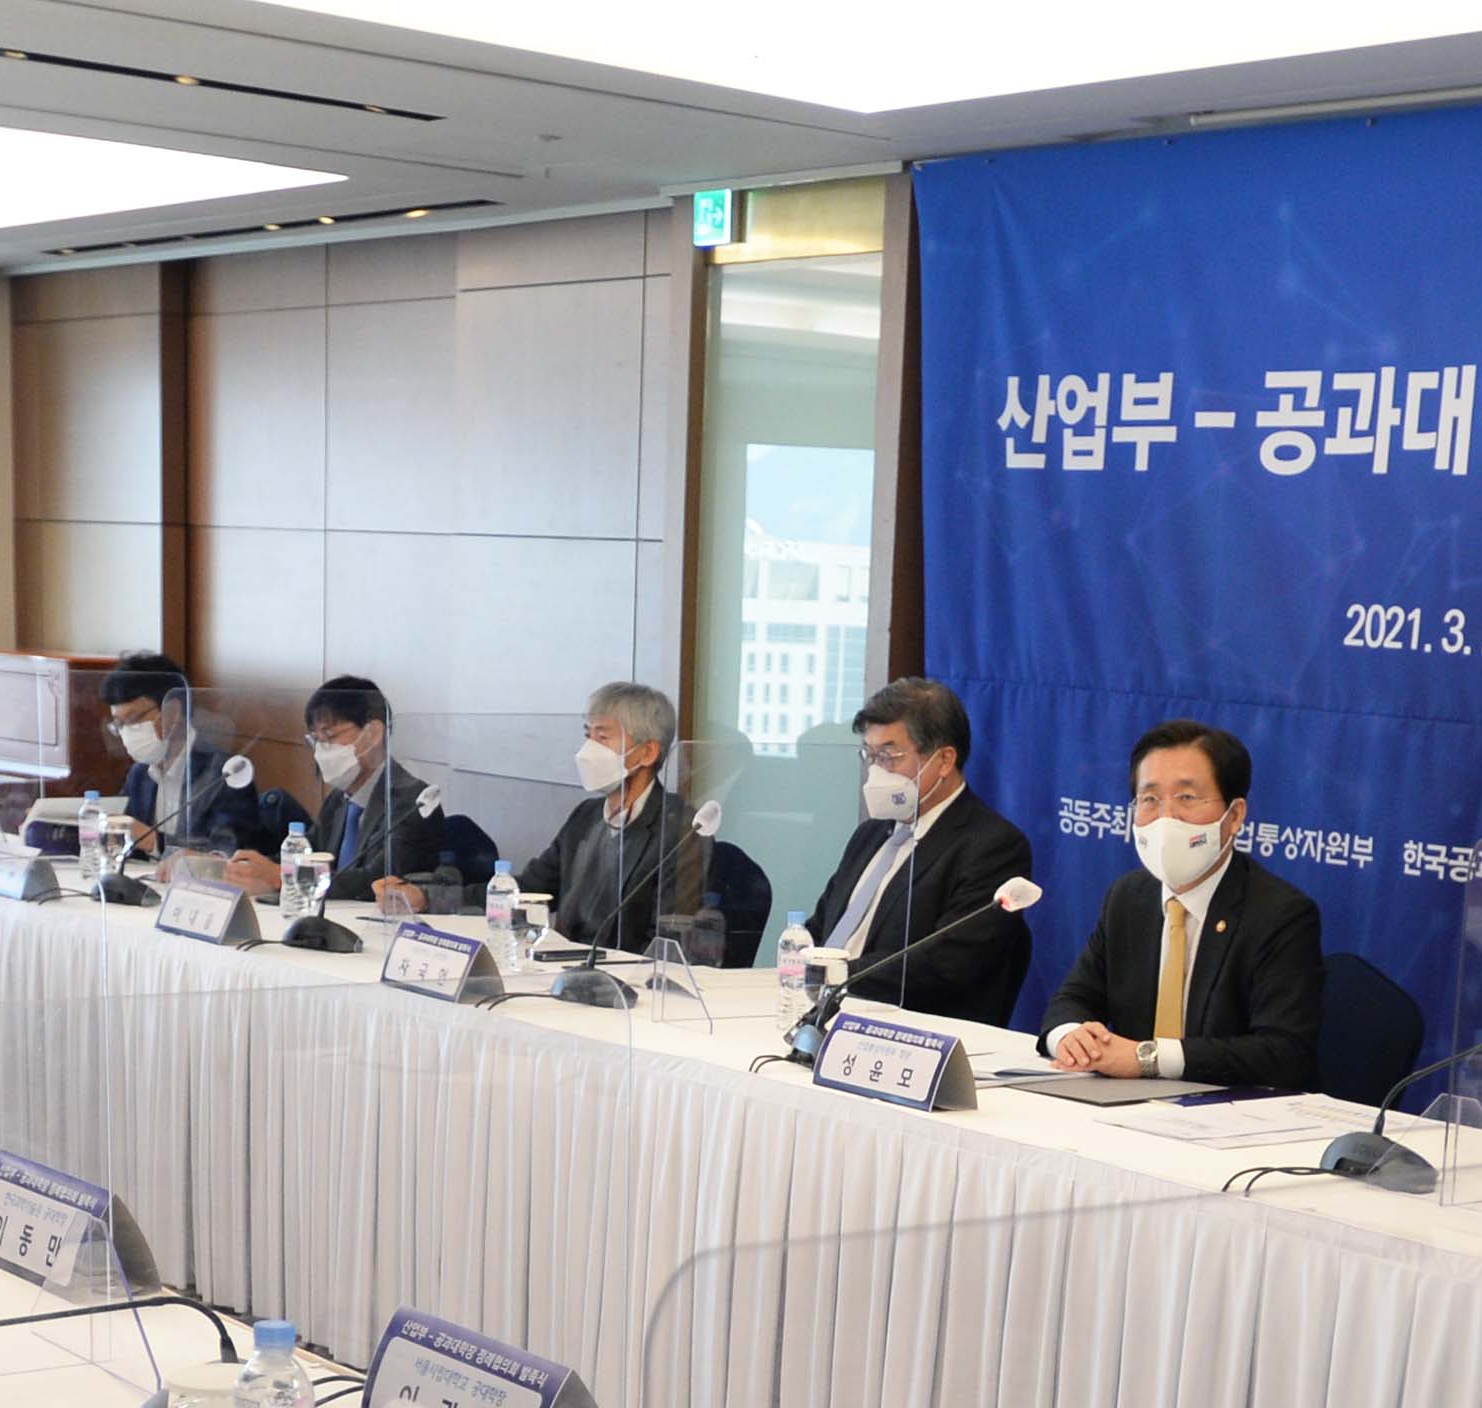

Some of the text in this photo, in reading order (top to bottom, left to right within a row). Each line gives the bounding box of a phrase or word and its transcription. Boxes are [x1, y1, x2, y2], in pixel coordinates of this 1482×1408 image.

[998, 373, 1177, 471] 산업부
[1344, 604, 1431, 652] 2021.
[1442, 609, 1471, 655] 3.
[1058, 796, 1132, 844] 공동주최
[1233, 821, 1374, 867] 업통상자원부
[842, 1053, 914, 1088] 성 윤 모
[19, 1224, 34, 1257] 동
